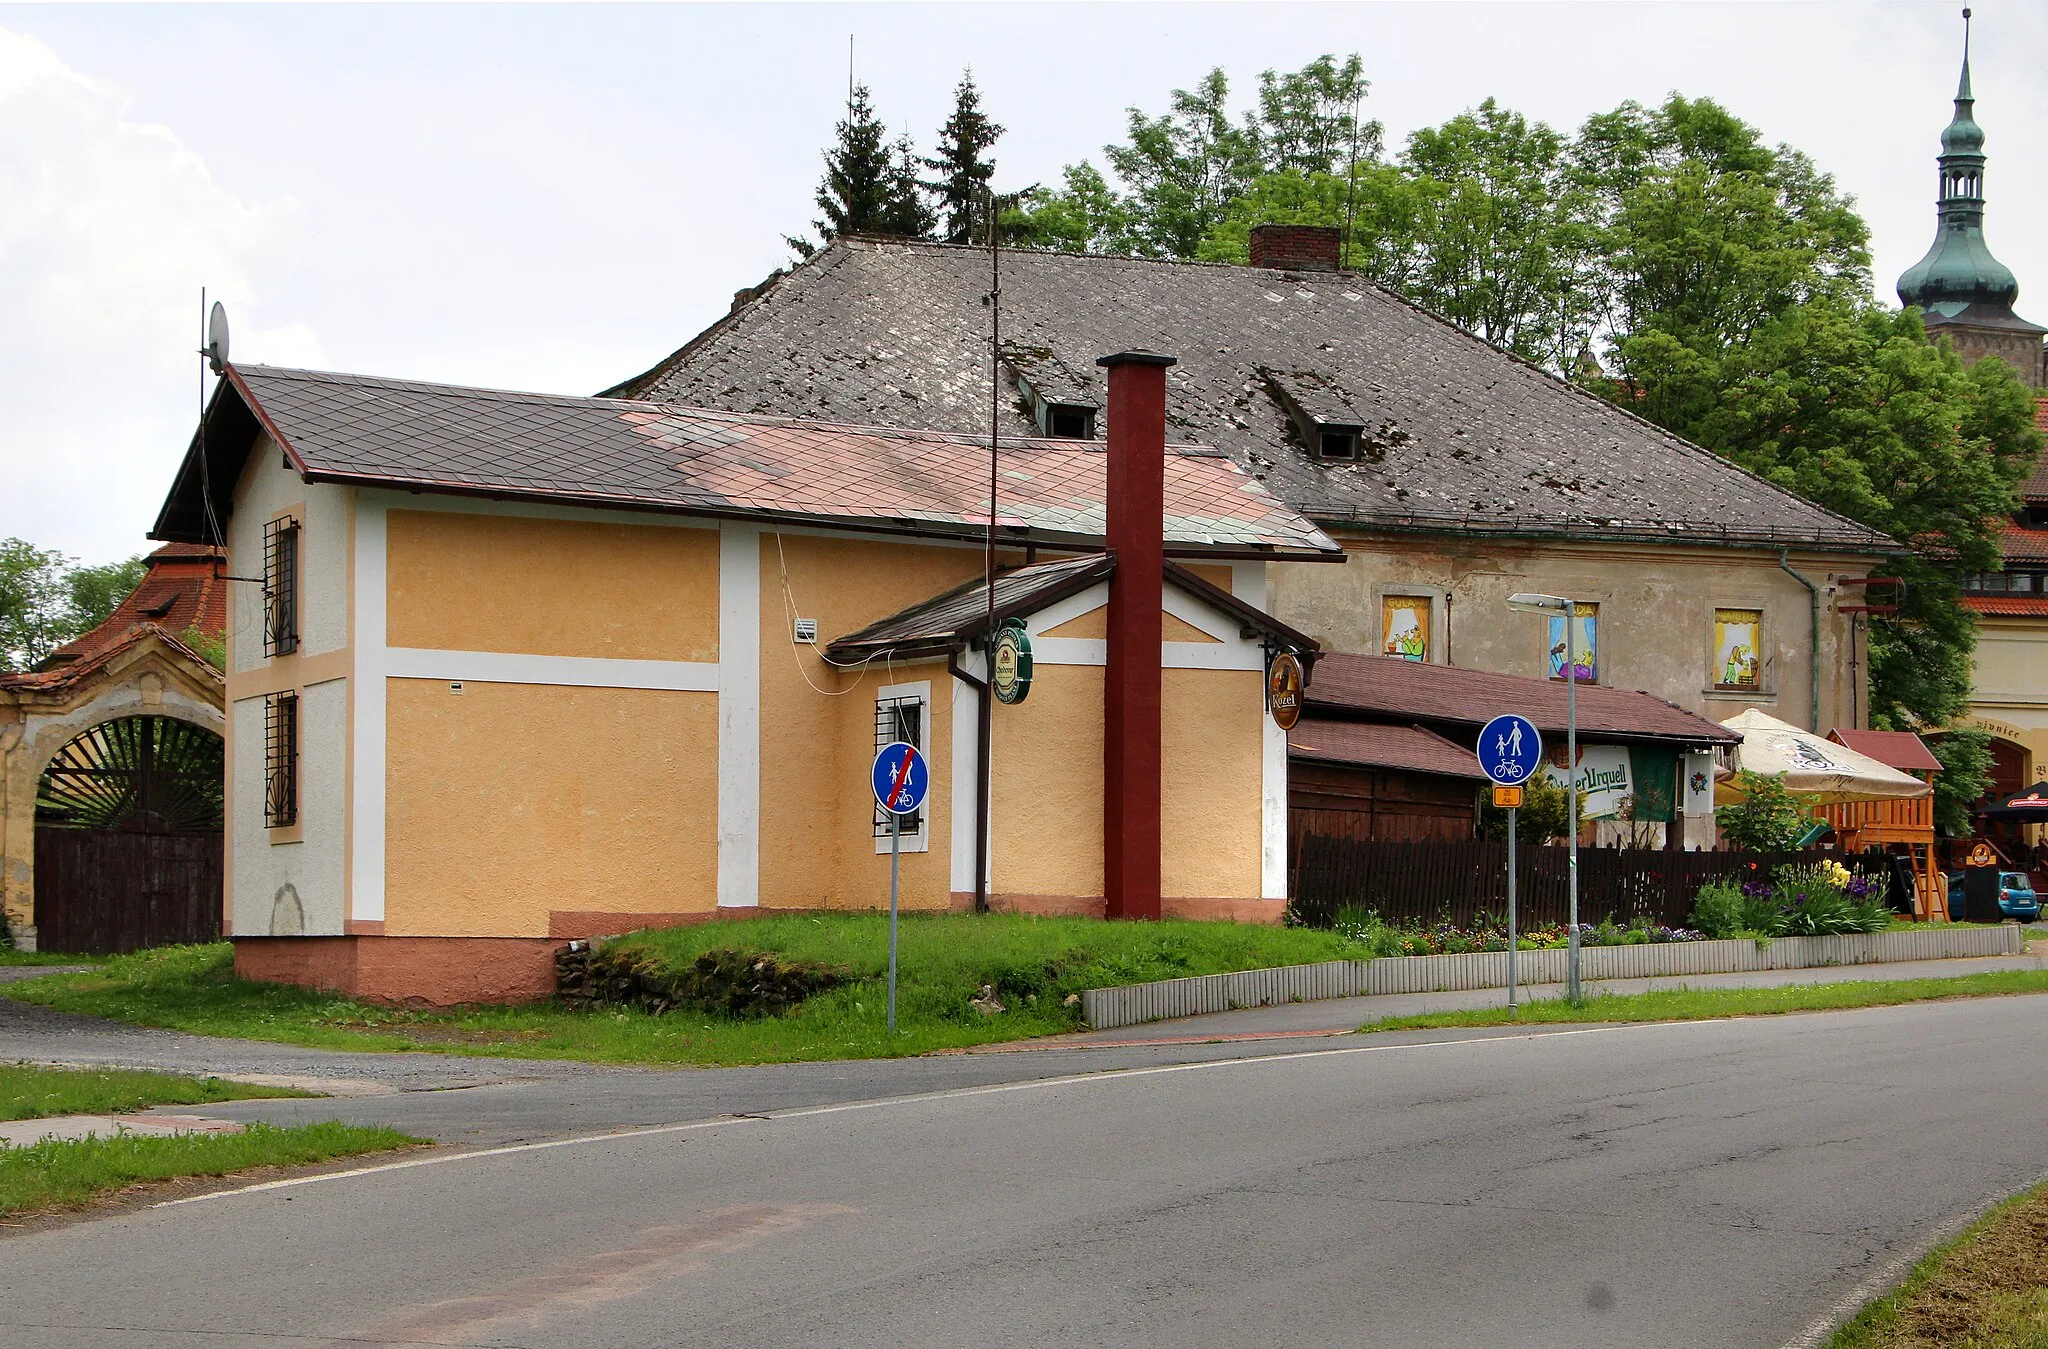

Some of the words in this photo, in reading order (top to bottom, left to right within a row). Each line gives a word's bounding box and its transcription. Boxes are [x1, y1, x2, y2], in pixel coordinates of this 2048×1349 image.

[1388, 598, 1415, 607] GULA
[1272, 693, 1296, 708] Kozel
[1584, 764, 1626, 793] Urquell
